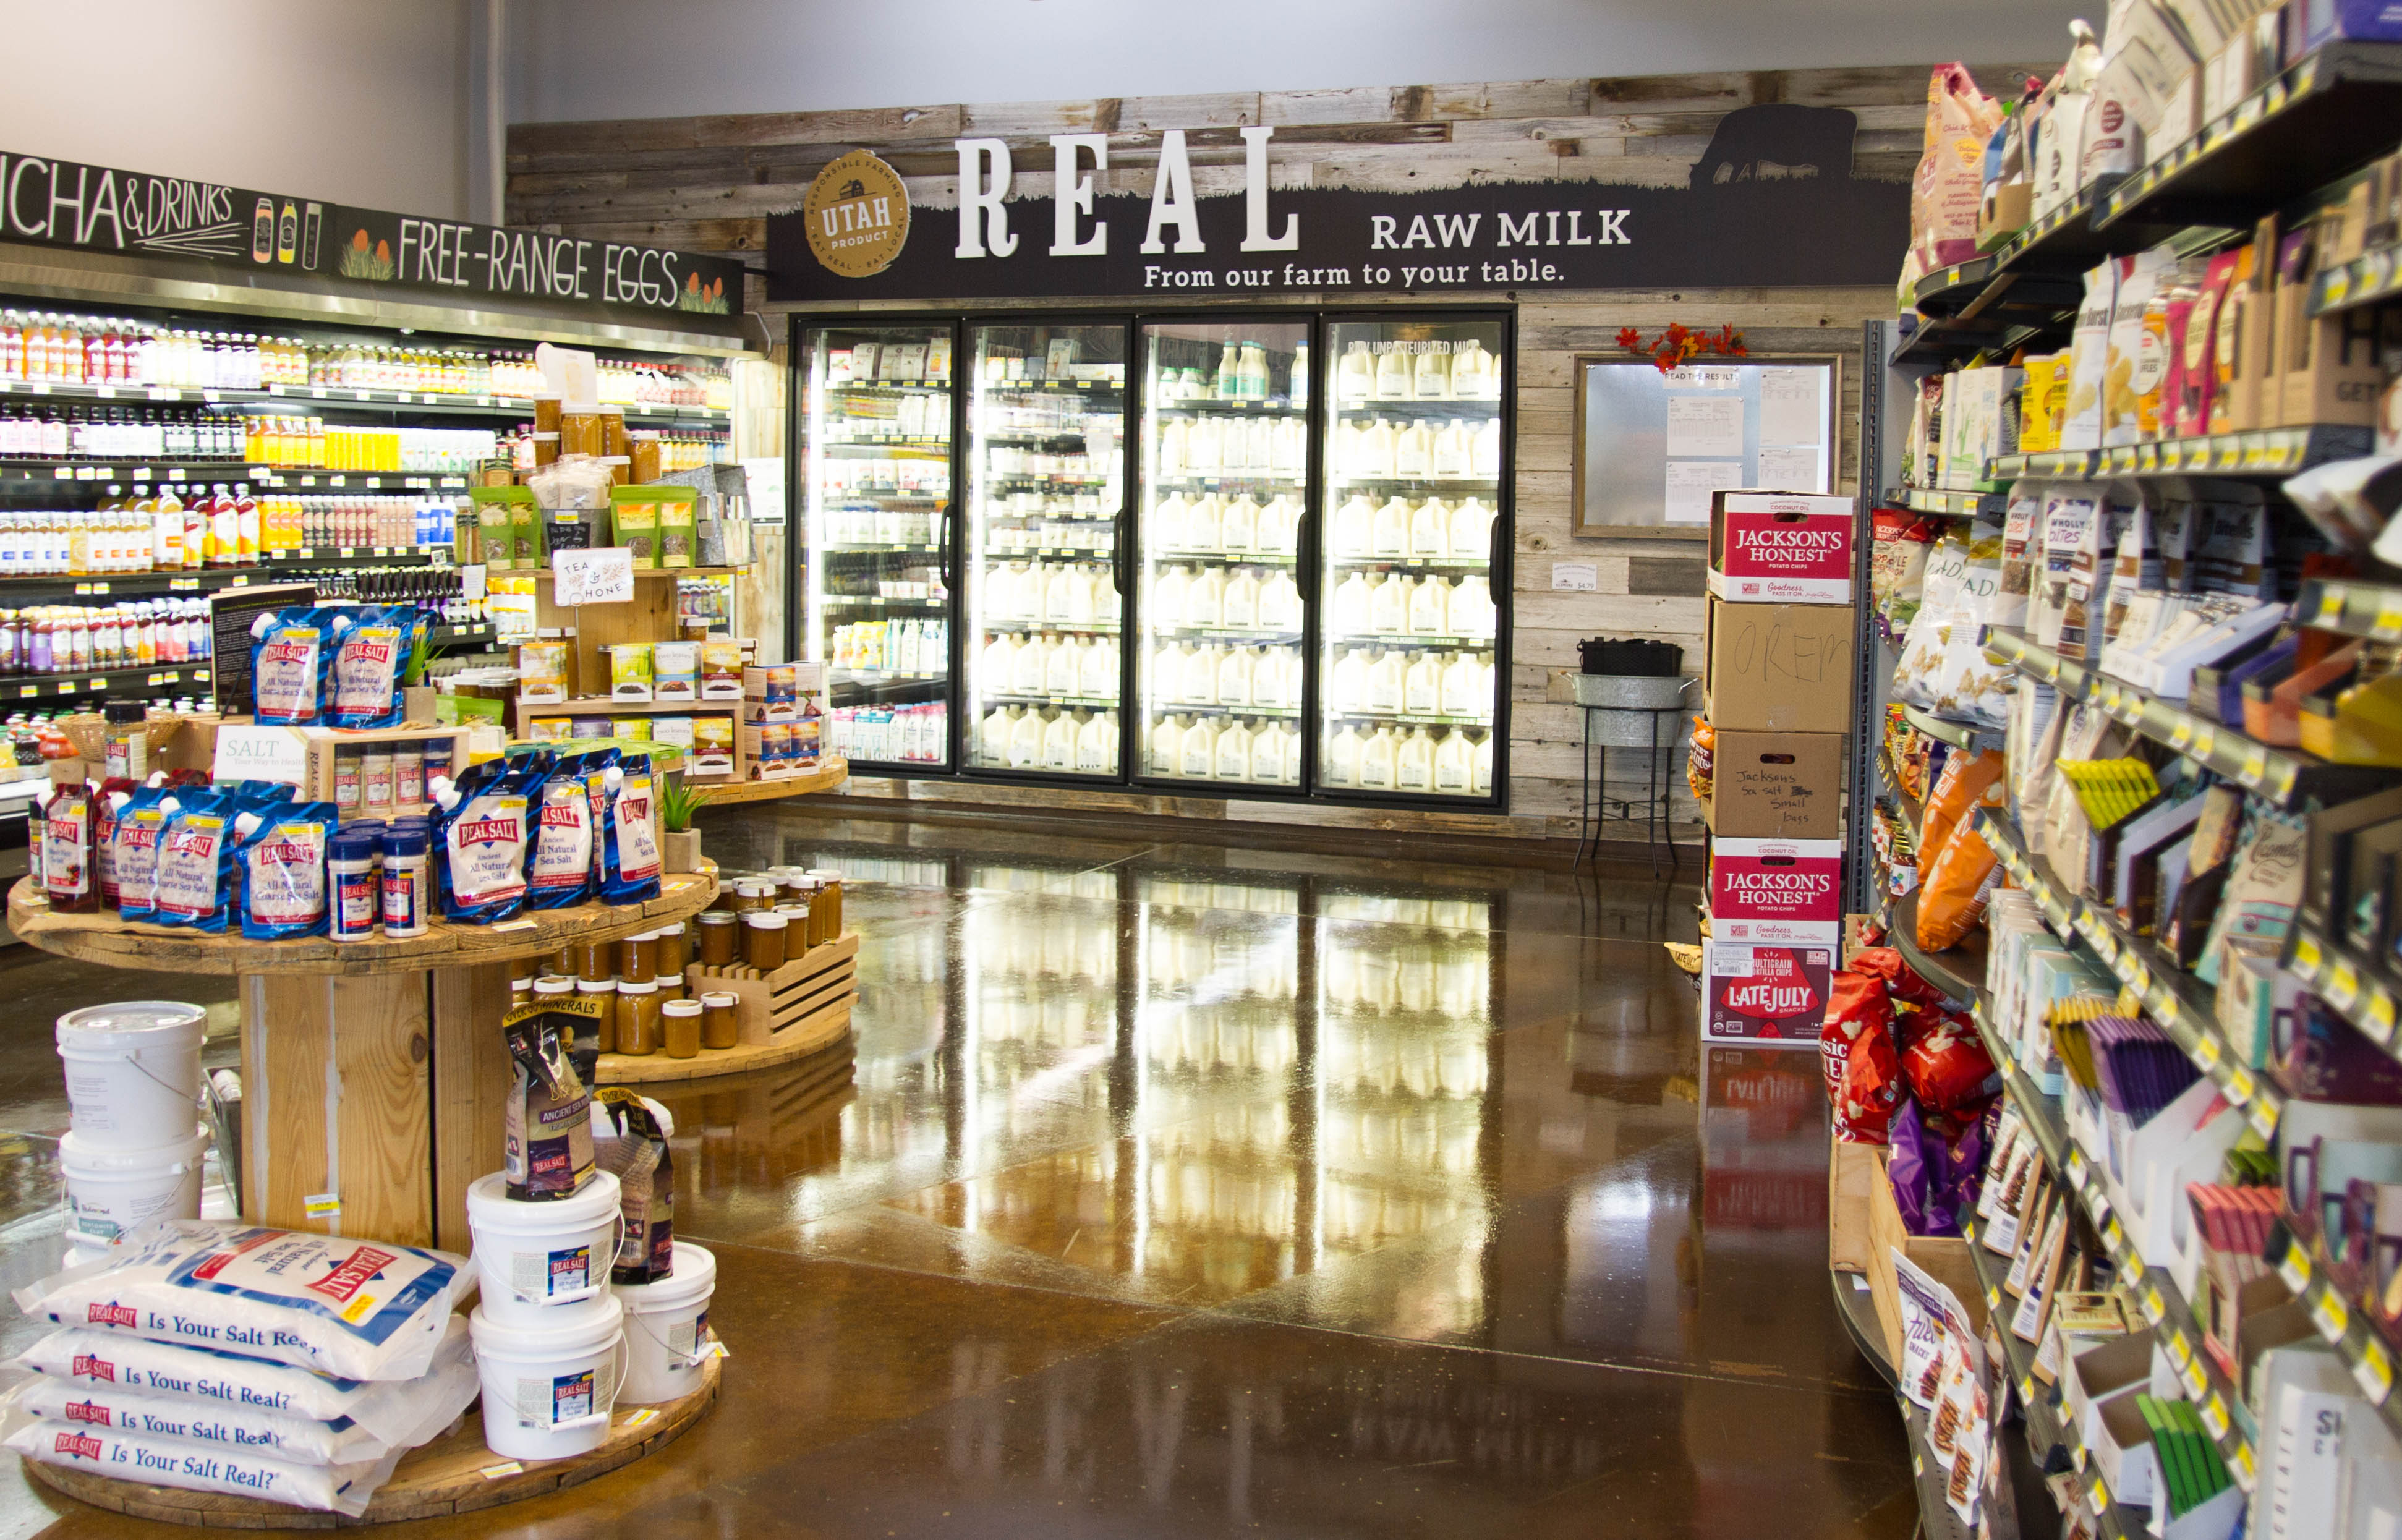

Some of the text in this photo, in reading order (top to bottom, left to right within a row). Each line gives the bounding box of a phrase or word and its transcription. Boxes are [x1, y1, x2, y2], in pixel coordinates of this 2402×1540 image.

[809, 160, 901, 215] RESPONSIBLE FARMING
[954, 126, 1299, 259] REAL
[0, 155, 124, 249] CHA
[147, 178, 234, 236] DRINKS
[821, 196, 892, 237] UTAH
[1371, 210, 1631, 249] RAW MILK
[811, 217, 905, 270] EAT REAL EAT LOCAL
[831, 231, 888, 250] PRODUCT
[398, 219, 678, 307] FREE-RANGE EGGS
[1144, 258, 1565, 287] From our farm to your table.
[1348, 341, 1370, 354] RAW
[2051, 519, 2085, 529] WHOLLY
[1735, 530, 1842, 550] JACKSON'S
[564, 561, 589, 574] TEA
[585, 580, 627, 598] HONE
[268, 645, 309, 661] REAL SALT
[346, 645, 388, 662] REAL SALT
[1734, 620, 1854, 683] OREM
[226, 739, 280, 757] SALT
[553, 806, 577, 824] SALT
[461, 820, 516, 845] REAL SALT
[189, 838, 211, 857] SALT
[263, 844, 312, 865] REAL SALT
[547, 844, 577, 854] Natural
[470, 864, 480, 873] All
[540, 855, 572, 865] Sea Salt
[163, 869, 203, 882] All Natural
[1724, 872, 1830, 893] JACKSON'S
[179, 883, 208, 893] Sea Salt
[265, 880, 278, 890] All
[342, 885, 360, 897] REAL
[393, 880, 409, 894] SALT
[303, 891, 320, 900] Salt
[1752, 968, 1774, 976] ORTILLA
[539, 1001, 596, 1015] MINERALS
[1729, 985, 1812, 1013] LATE JULY
[543, 1105, 571, 1122] ANCIENT
[535, 1155, 566, 1173] REAL SALT
[553, 1257, 586, 1274] REAL SALT
[89, 1304, 264, 1346] REAL SALT Is Your Salt
[93, 1359, 291, 1410] SALT Is Your Salt Real?
[558, 1382, 590, 1399] REAL SALT
[66, 1403, 89, 1421] REAL
[88, 1405, 110, 1426] SALT
[121, 1411, 136, 1429] Is
[143, 1415, 187, 1436] Your
[192, 1423, 228, 1442] Salt
[56, 1433, 275, 1489] REAL SALT Is Your Salt Real?
